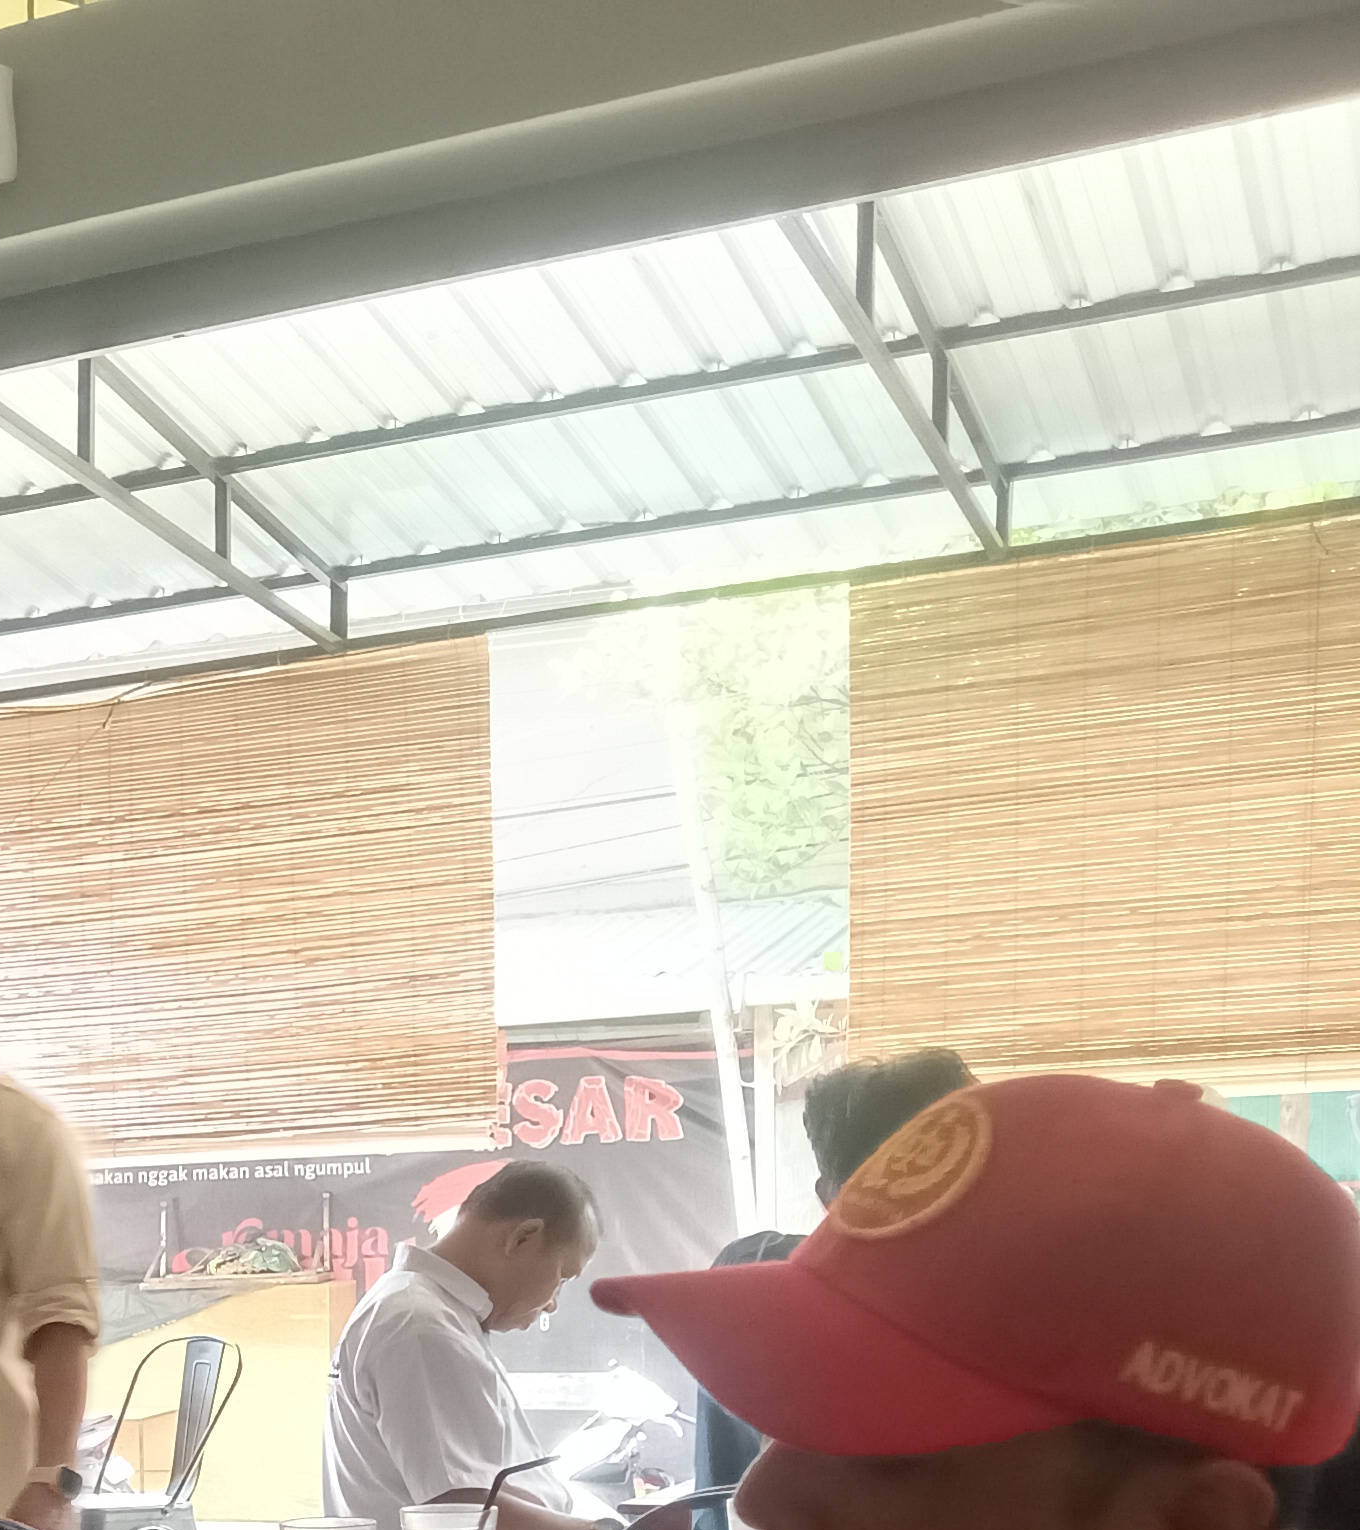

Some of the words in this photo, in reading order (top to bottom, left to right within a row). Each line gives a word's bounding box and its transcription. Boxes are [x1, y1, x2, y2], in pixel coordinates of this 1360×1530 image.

[137, 1165, 189, 1187] nggak
[192, 1163, 250, 1182] makan
[254, 1160, 290, 1179] asal
[293, 1157, 372, 1181] ngumpul
[1118, 1340, 1305, 1433] ADVOKAT
